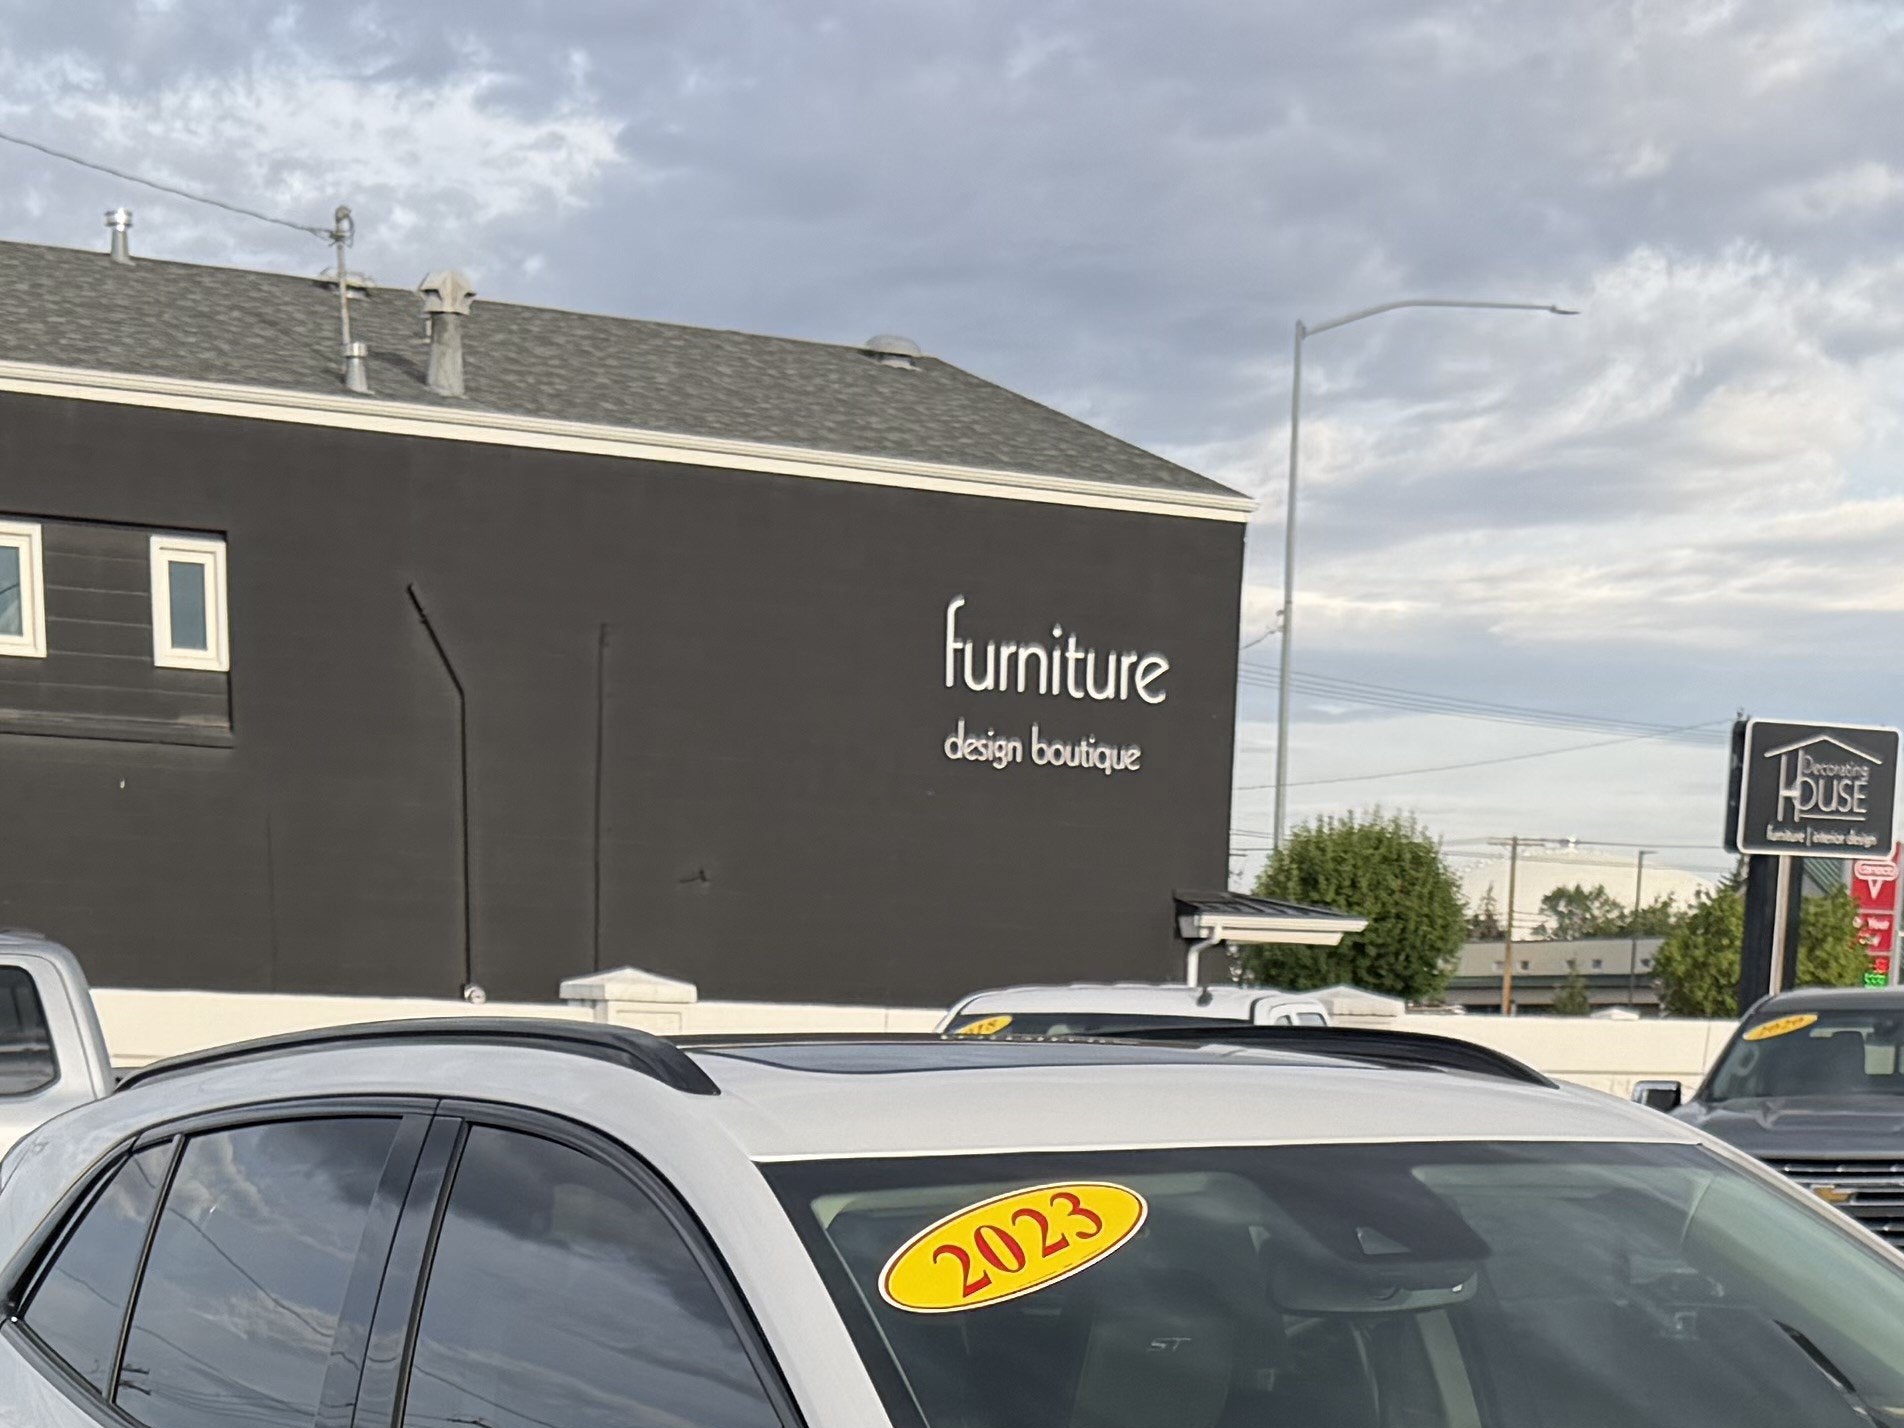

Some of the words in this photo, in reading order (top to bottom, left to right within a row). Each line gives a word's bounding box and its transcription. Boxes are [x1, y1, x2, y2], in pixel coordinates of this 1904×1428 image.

[945, 593, 1170, 704] furniture
[944, 717, 1023, 769] design
[1031, 722, 1142, 775] boutique
[932, 1191, 1103, 1298] 2023
